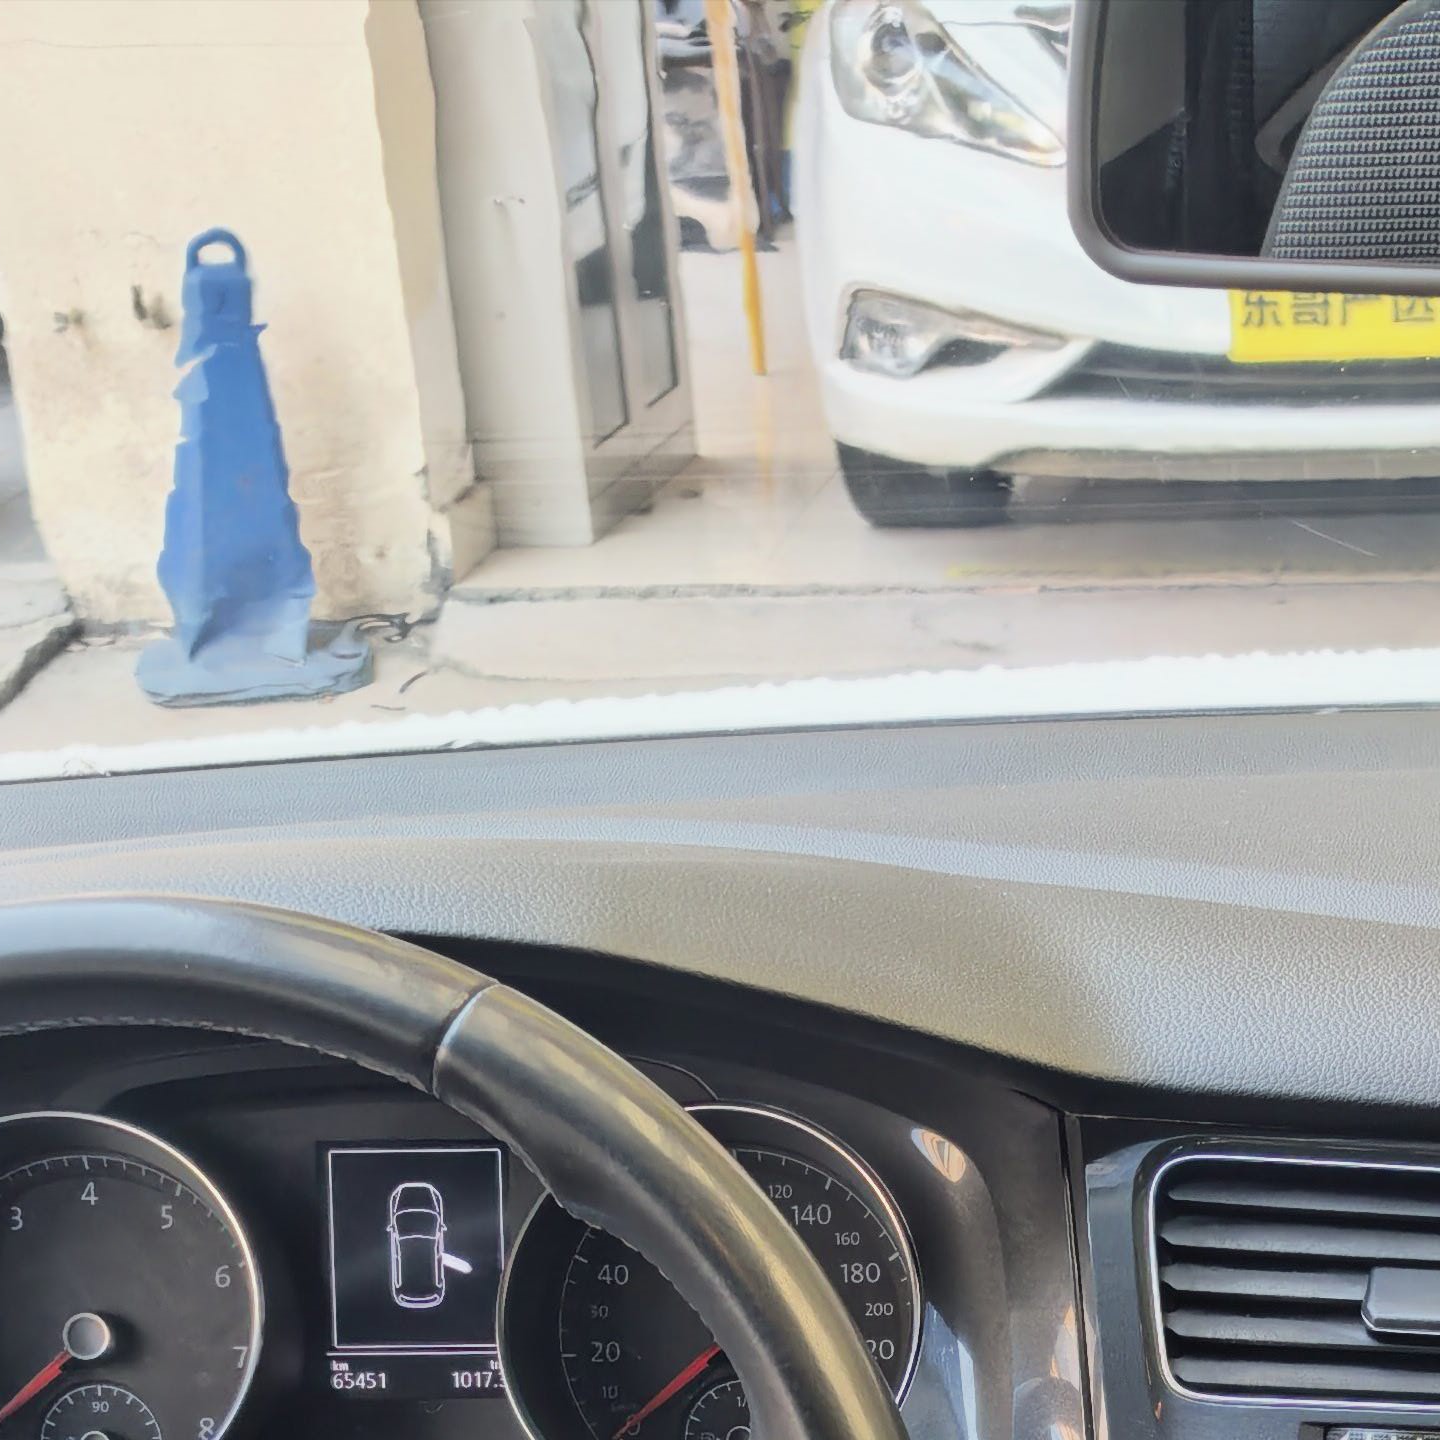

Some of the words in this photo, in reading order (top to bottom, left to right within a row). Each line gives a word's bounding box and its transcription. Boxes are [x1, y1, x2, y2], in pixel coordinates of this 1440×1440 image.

[81, 1182, 99, 1206] 4
[768, 1184, 793, 1199] 120
[9, 1206, 24, 1231] 3
[161, 1205, 174, 1230] 5
[791, 1204, 833, 1226] 140
[834, 1231, 861, 1247] 160
[215, 1265, 231, 1289] 6
[597, 1263, 630, 1286] 40
[840, 1262, 881, 1284] 180
[864, 1302, 894, 1317] 200
[232, 1346, 248, 1370] 7
[591, 1341, 621, 1363] 20
[866, 1339, 895, 1361] 20
[332, 1360, 349, 1371] km
[332, 1371, 387, 1389] 65451
[91, 1400, 110, 1414] 90
[198, 1417, 216, 1440] 8
